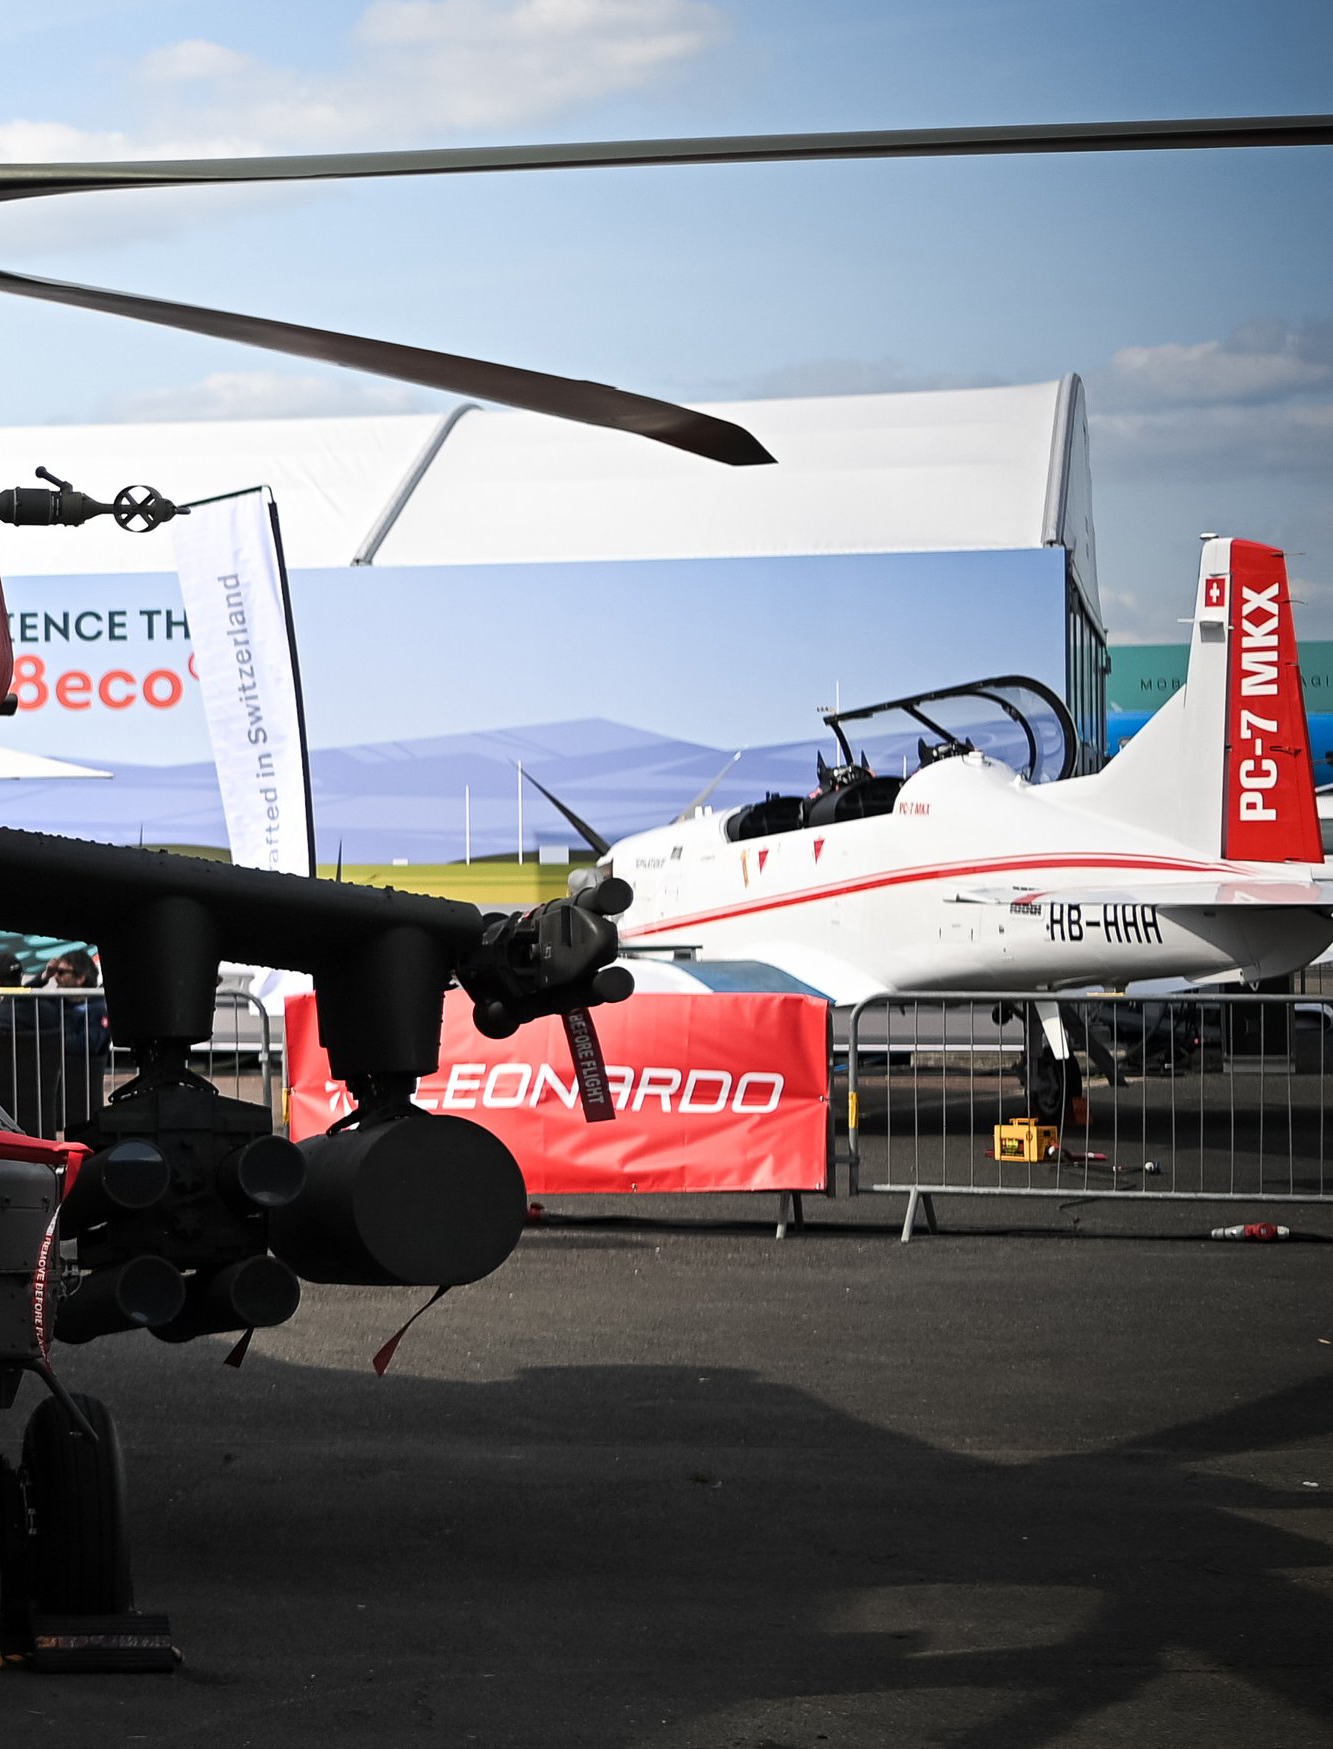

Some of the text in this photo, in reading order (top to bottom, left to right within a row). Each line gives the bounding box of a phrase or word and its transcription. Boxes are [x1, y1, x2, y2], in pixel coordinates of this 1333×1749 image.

[139, 608, 191, 640] TH
[217, 573, 269, 744] Switzerland
[1140, 677, 1182, 691] MOB
[1239, 582, 1279, 821] PC-7 MKX
[256, 752, 275, 779] in
[1050, 901, 1164, 944] HB-HHH
[580, 1060, 604, 1104] FLIGHT
[36, 1236, 52, 1281] REMOVE
